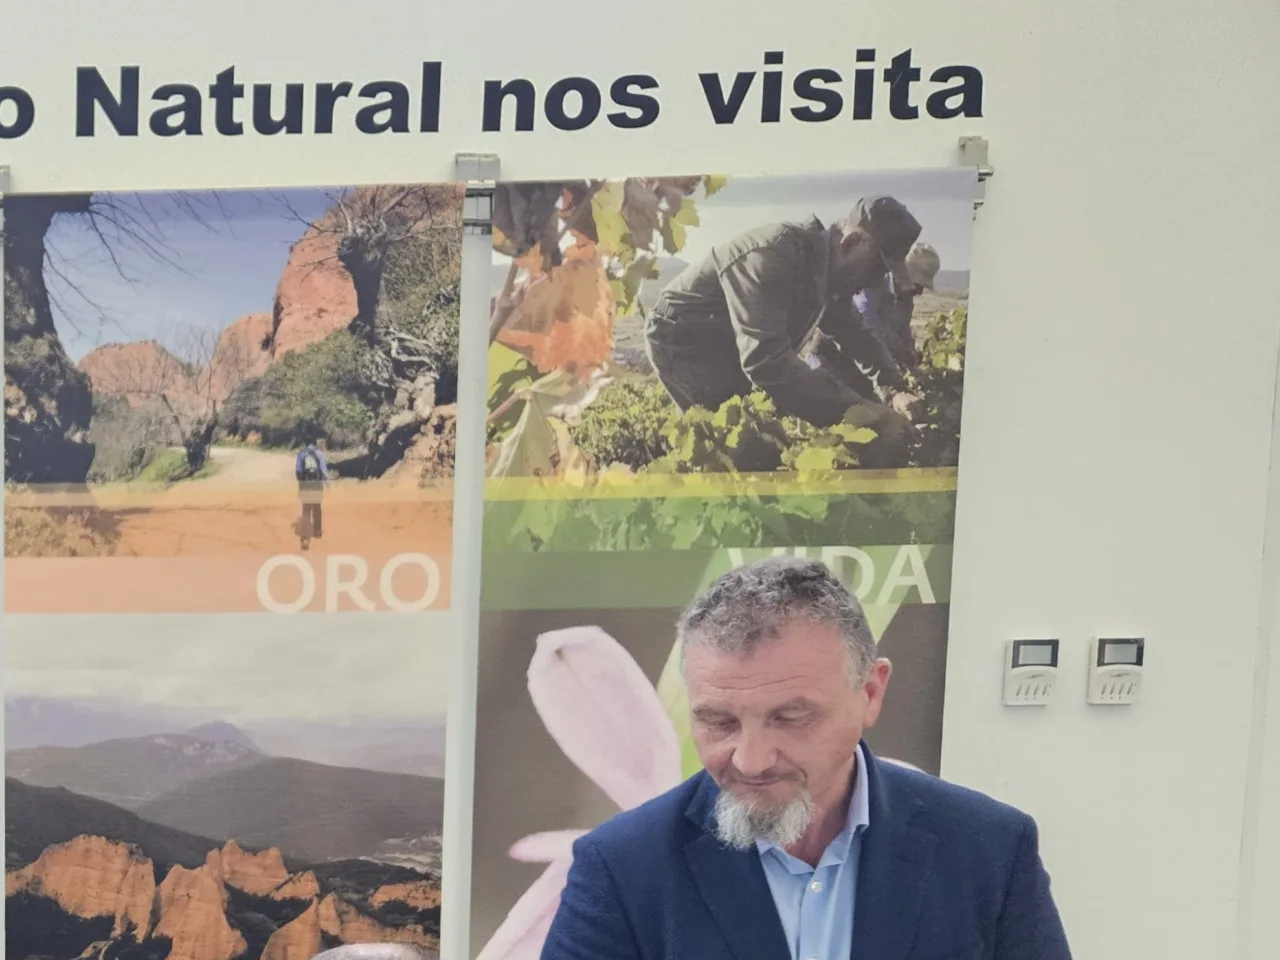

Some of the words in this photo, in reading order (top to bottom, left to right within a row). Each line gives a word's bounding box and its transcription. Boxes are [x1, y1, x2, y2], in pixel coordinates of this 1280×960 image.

[75, 62, 442, 137] Natural
[482, 75, 660, 132] nos
[698, 49, 984, 125] visita
[256, 552, 440, 615] ORO
[727, 544, 936, 604] DA
